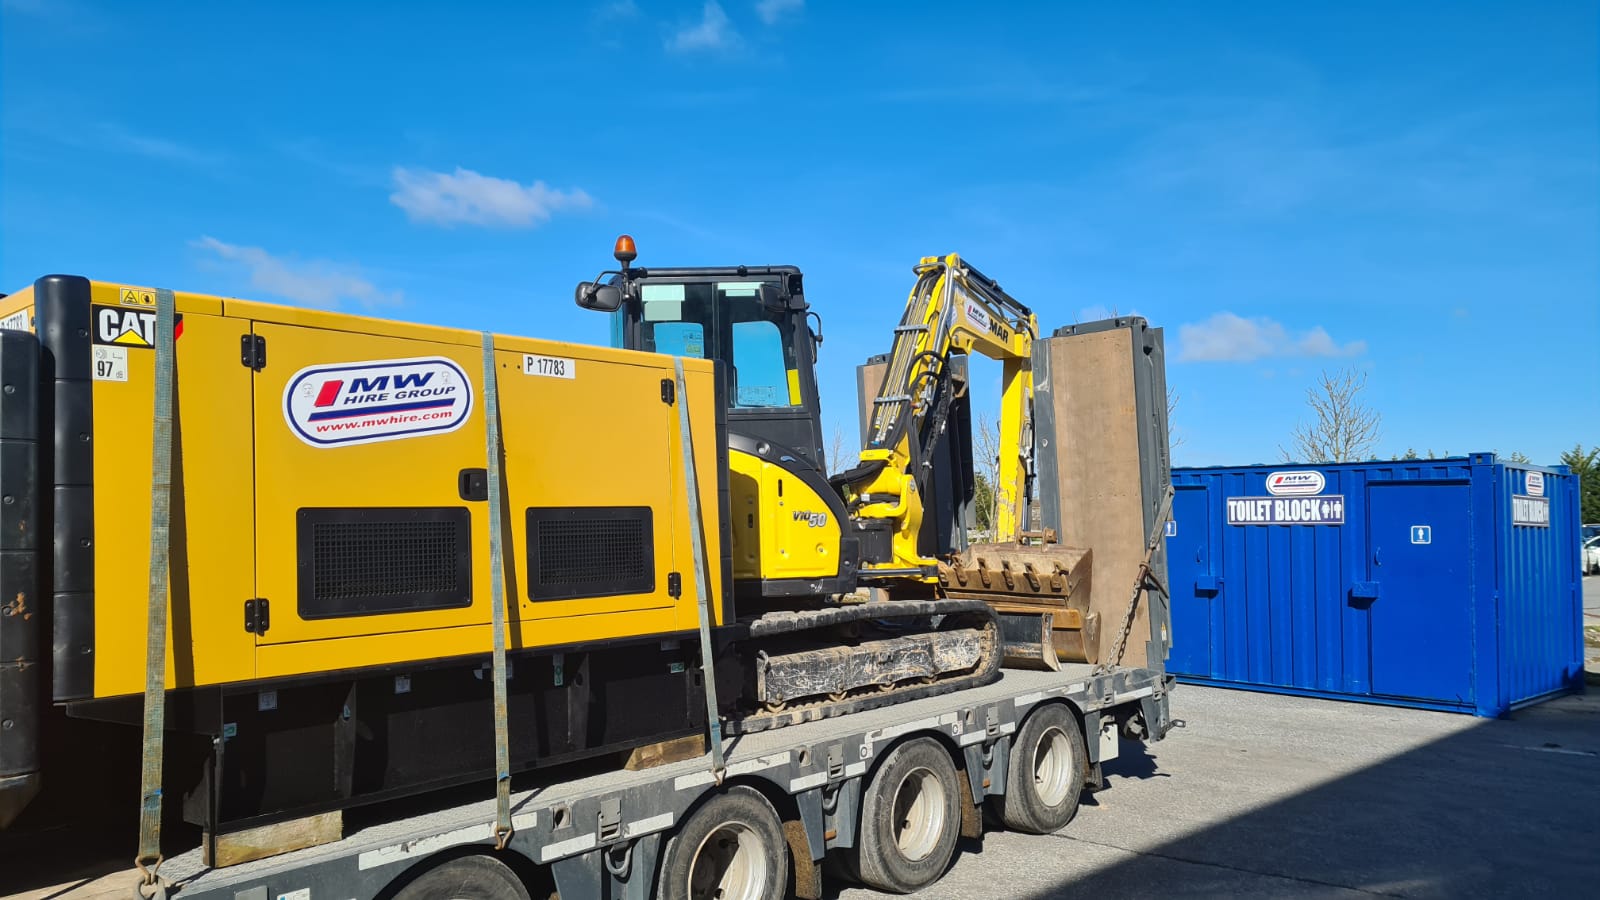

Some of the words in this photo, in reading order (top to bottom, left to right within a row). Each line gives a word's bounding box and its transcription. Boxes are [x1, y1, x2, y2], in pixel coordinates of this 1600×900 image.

[99, 308, 156, 346] CAT
[989, 317, 1009, 344] MAR
[97, 360, 114, 377] 97
[527, 356, 534, 373] P
[537, 358, 565, 376] 17783
[348, 372, 435, 394] MW
[343, 392, 390, 406] HIRE
[394, 386, 456, 401] GROUP
[316, 411, 453, 432] www.mwhire.com
[1228, 500, 1272, 521] TOILET
[1274, 499, 1321, 521] BLOCK
